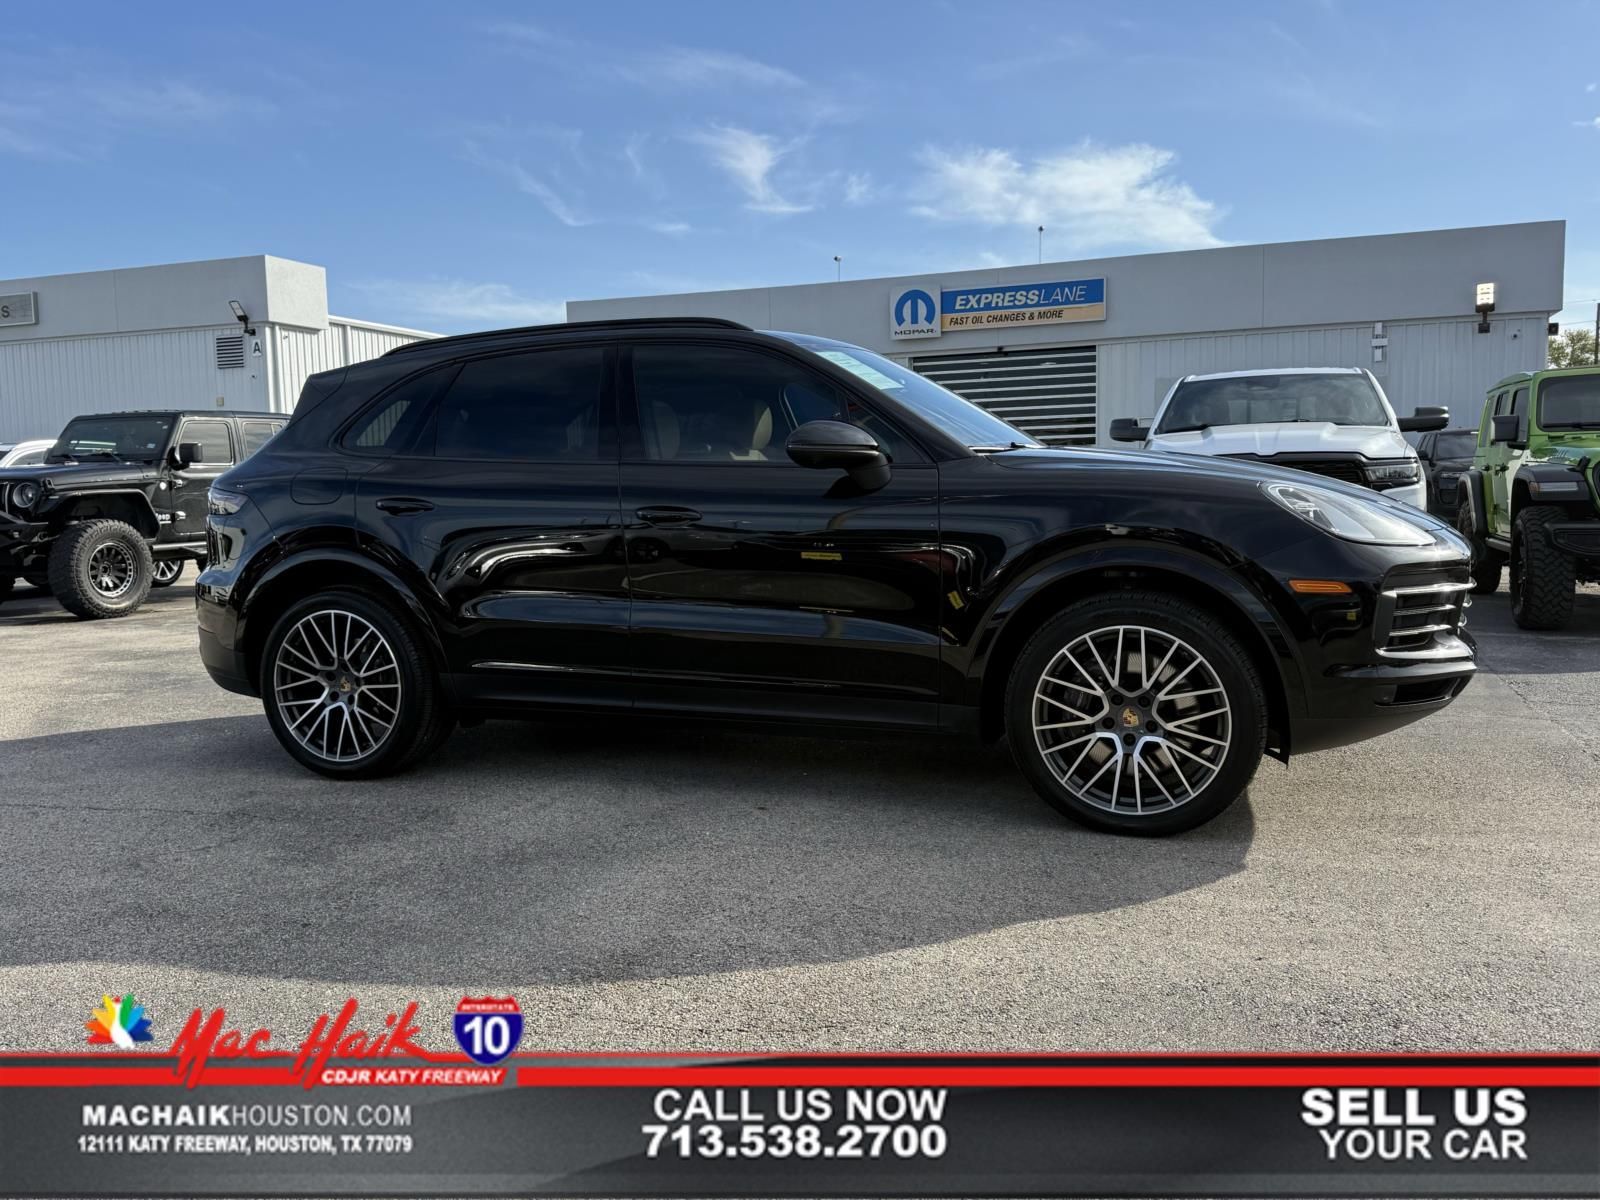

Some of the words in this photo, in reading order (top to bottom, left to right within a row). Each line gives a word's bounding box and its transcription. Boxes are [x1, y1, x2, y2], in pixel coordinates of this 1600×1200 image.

[949, 316, 970, 326] FAST
[971, 315, 984, 325] OIL
[986, 312, 1026, 323] CHANGES
[1028, 311, 1035, 321] &
[1037, 309, 1064, 320] MORE
[894, 328, 934, 337] MOPAR
[252, 341, 261, 354] A
